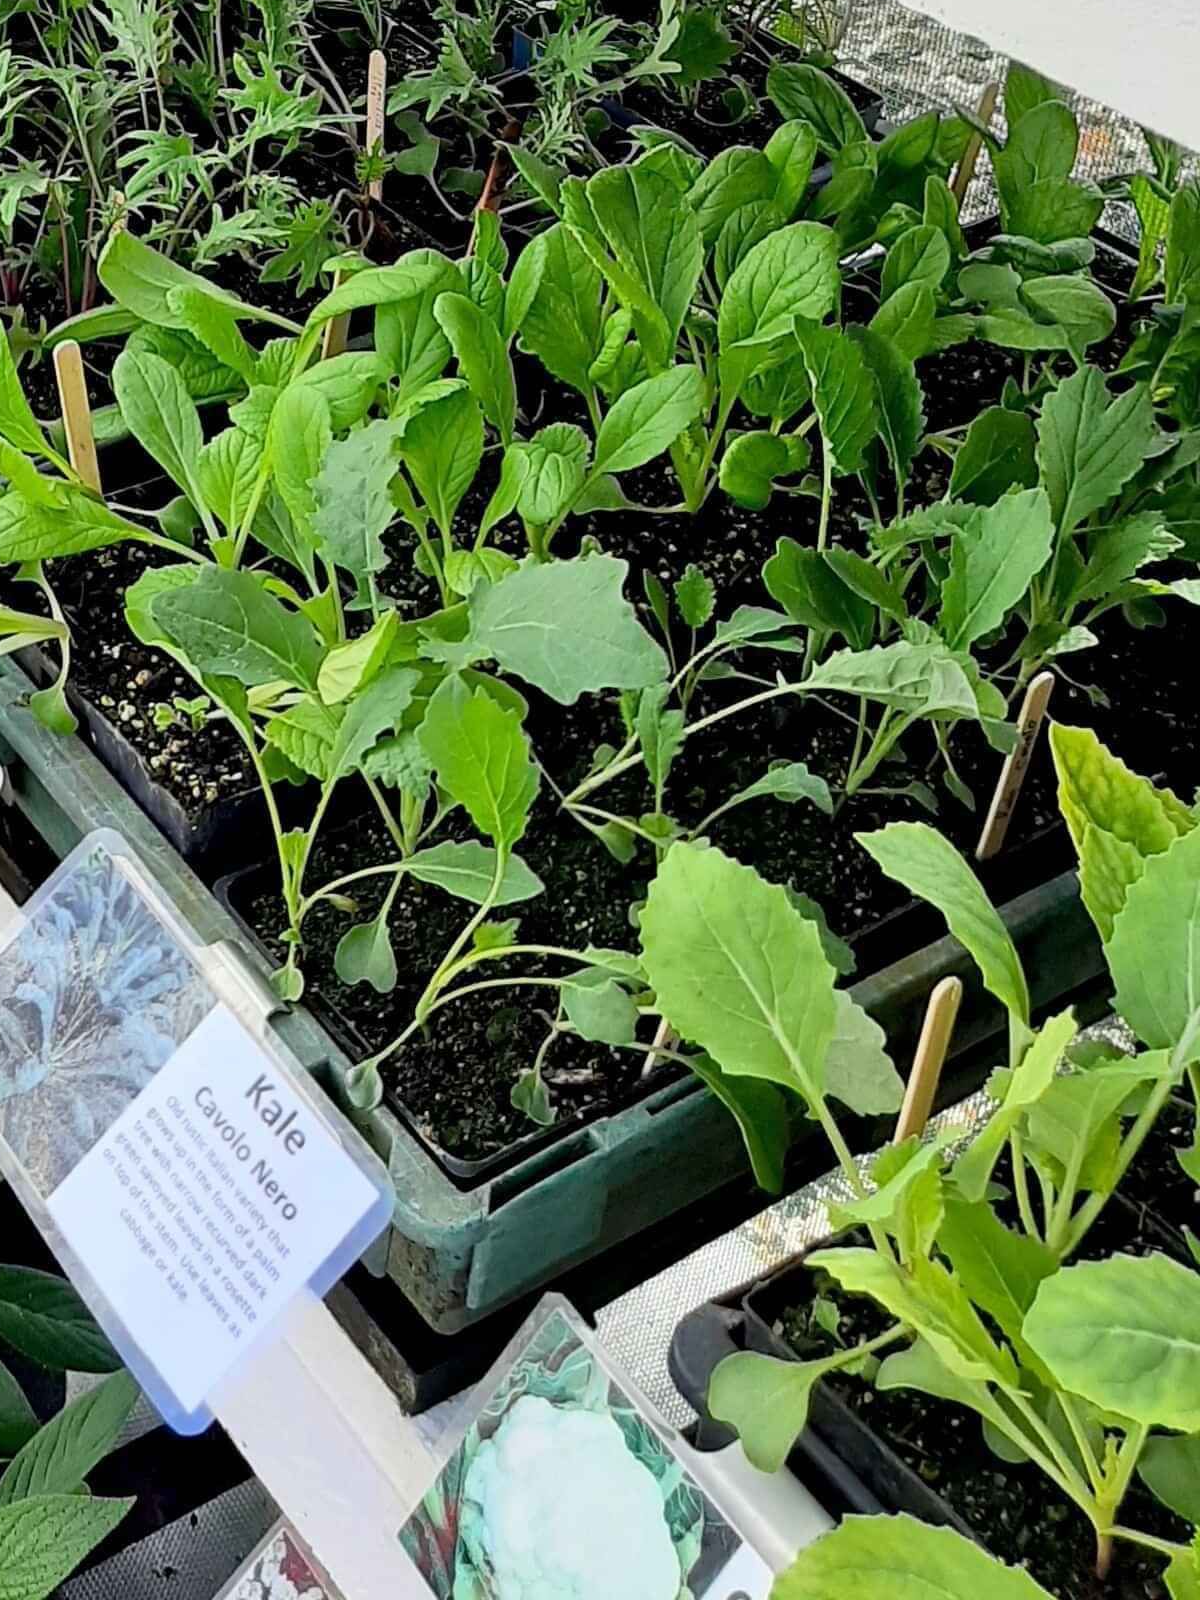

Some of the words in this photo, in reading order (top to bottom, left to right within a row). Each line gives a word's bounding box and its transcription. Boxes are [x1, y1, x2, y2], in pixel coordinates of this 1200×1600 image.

[194, 1085, 252, 1162] Cavolo
[250, 1159, 298, 1221] Nero
[245, 1073, 306, 1156] Kale
[103, 1148, 116, 1165] on
[114, 1163, 130, 1186] top
[129, 1186, 143, 1199] of
[140, 1198, 156, 1221] the
[180, 1255, 200, 1281] Use
[198, 1278, 229, 1323] leaves
[229, 1323, 241, 1338] as
[115, 1133, 141, 1165] green
[174, 1210, 204, 1252] leaves
[203, 1249, 214, 1265] in
[213, 1267, 221, 1276] a
[221, 1276, 256, 1322] rosette
[120, 1209, 156, 1259] cabbage
[155, 1259, 168, 1272] or
[134, 1120, 152, 1146] tree
[152, 1145, 171, 1172] with
[243, 1271, 267, 1300] dark
[173, 1141, 187, 1158] up
[185, 1157, 196, 1171] in
[196, 1170, 212, 1192] the
[212, 1191, 235, 1224] form
[235, 1224, 250, 1238] of
[246, 1240, 254, 1249] a
[252, 1248, 280, 1281] palm
[235, 1189, 268, 1231] variety
[267, 1229, 290, 1259] that
